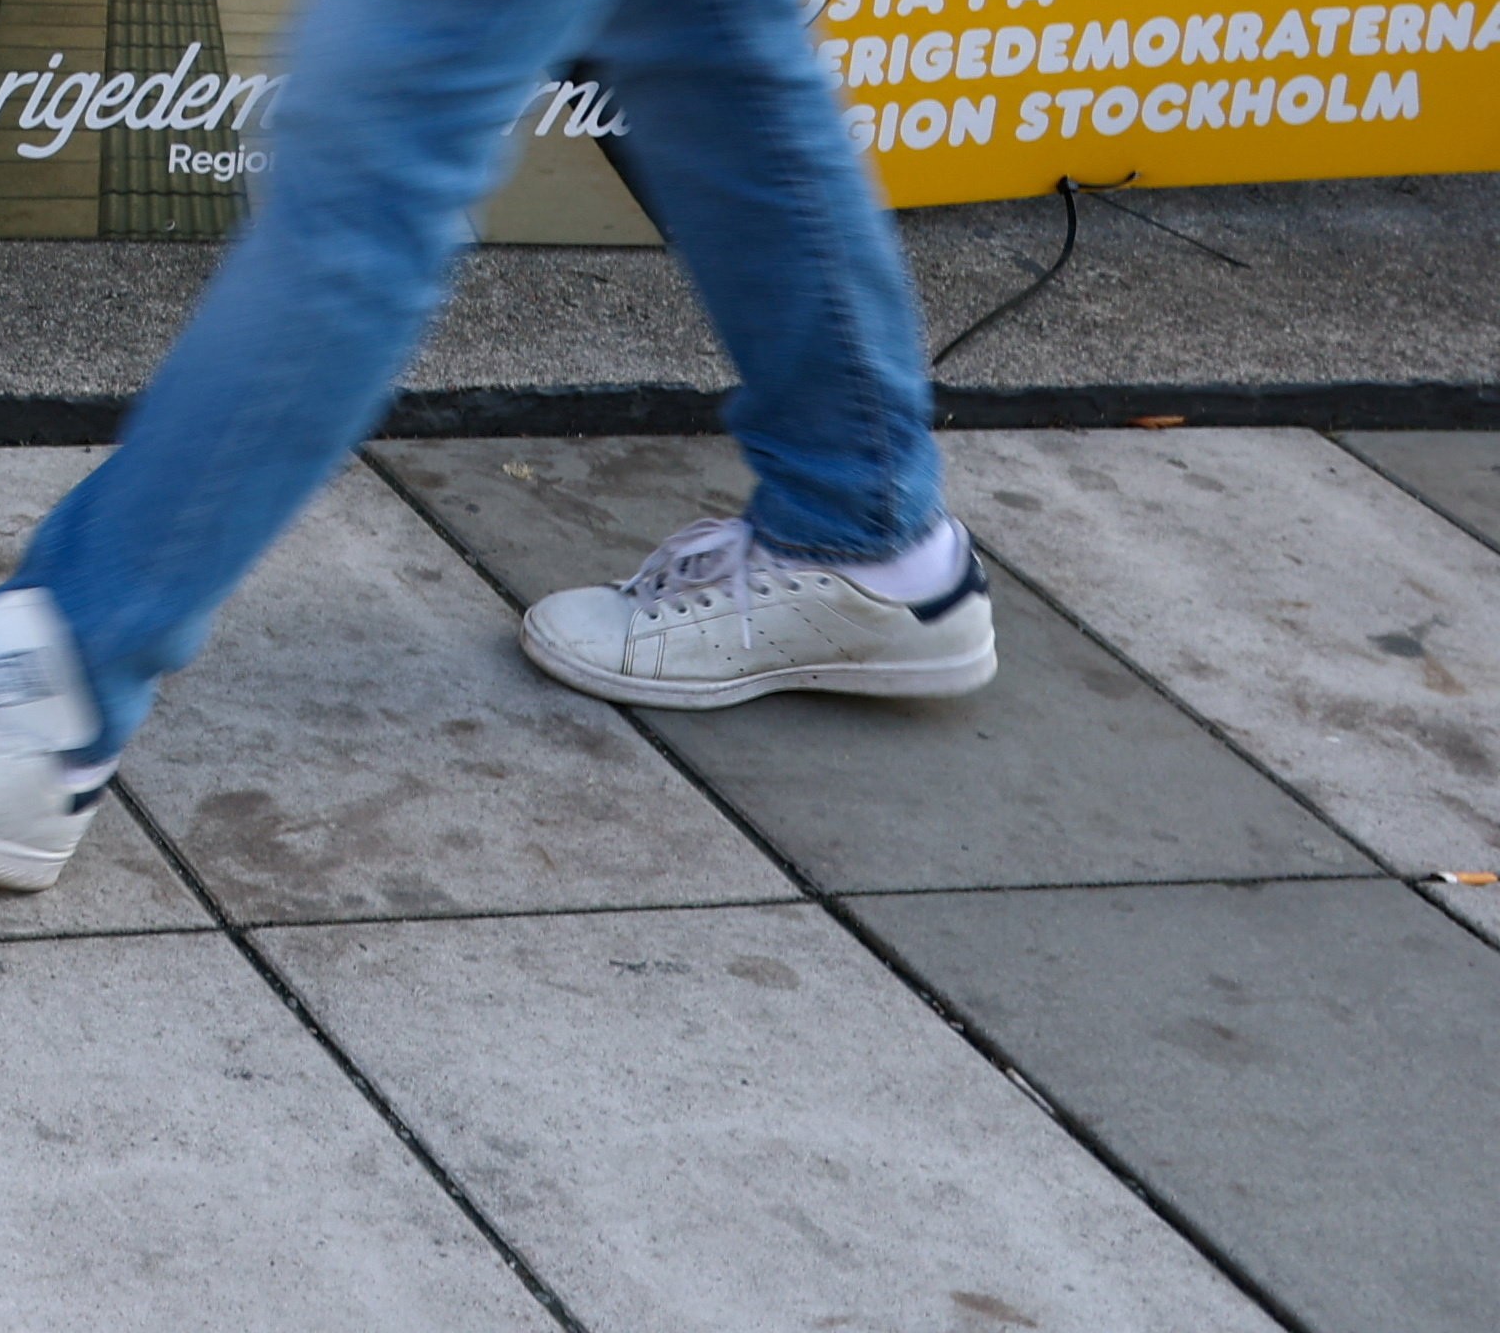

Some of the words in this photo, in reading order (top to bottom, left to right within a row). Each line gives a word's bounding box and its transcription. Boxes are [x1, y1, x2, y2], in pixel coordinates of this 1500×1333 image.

[812, 1, 1500, 90] ERIGEDEMOKRATERNA
[1015, 70, 1421, 144] STOCKHOLM
[168, 142, 276, 181] Regio
